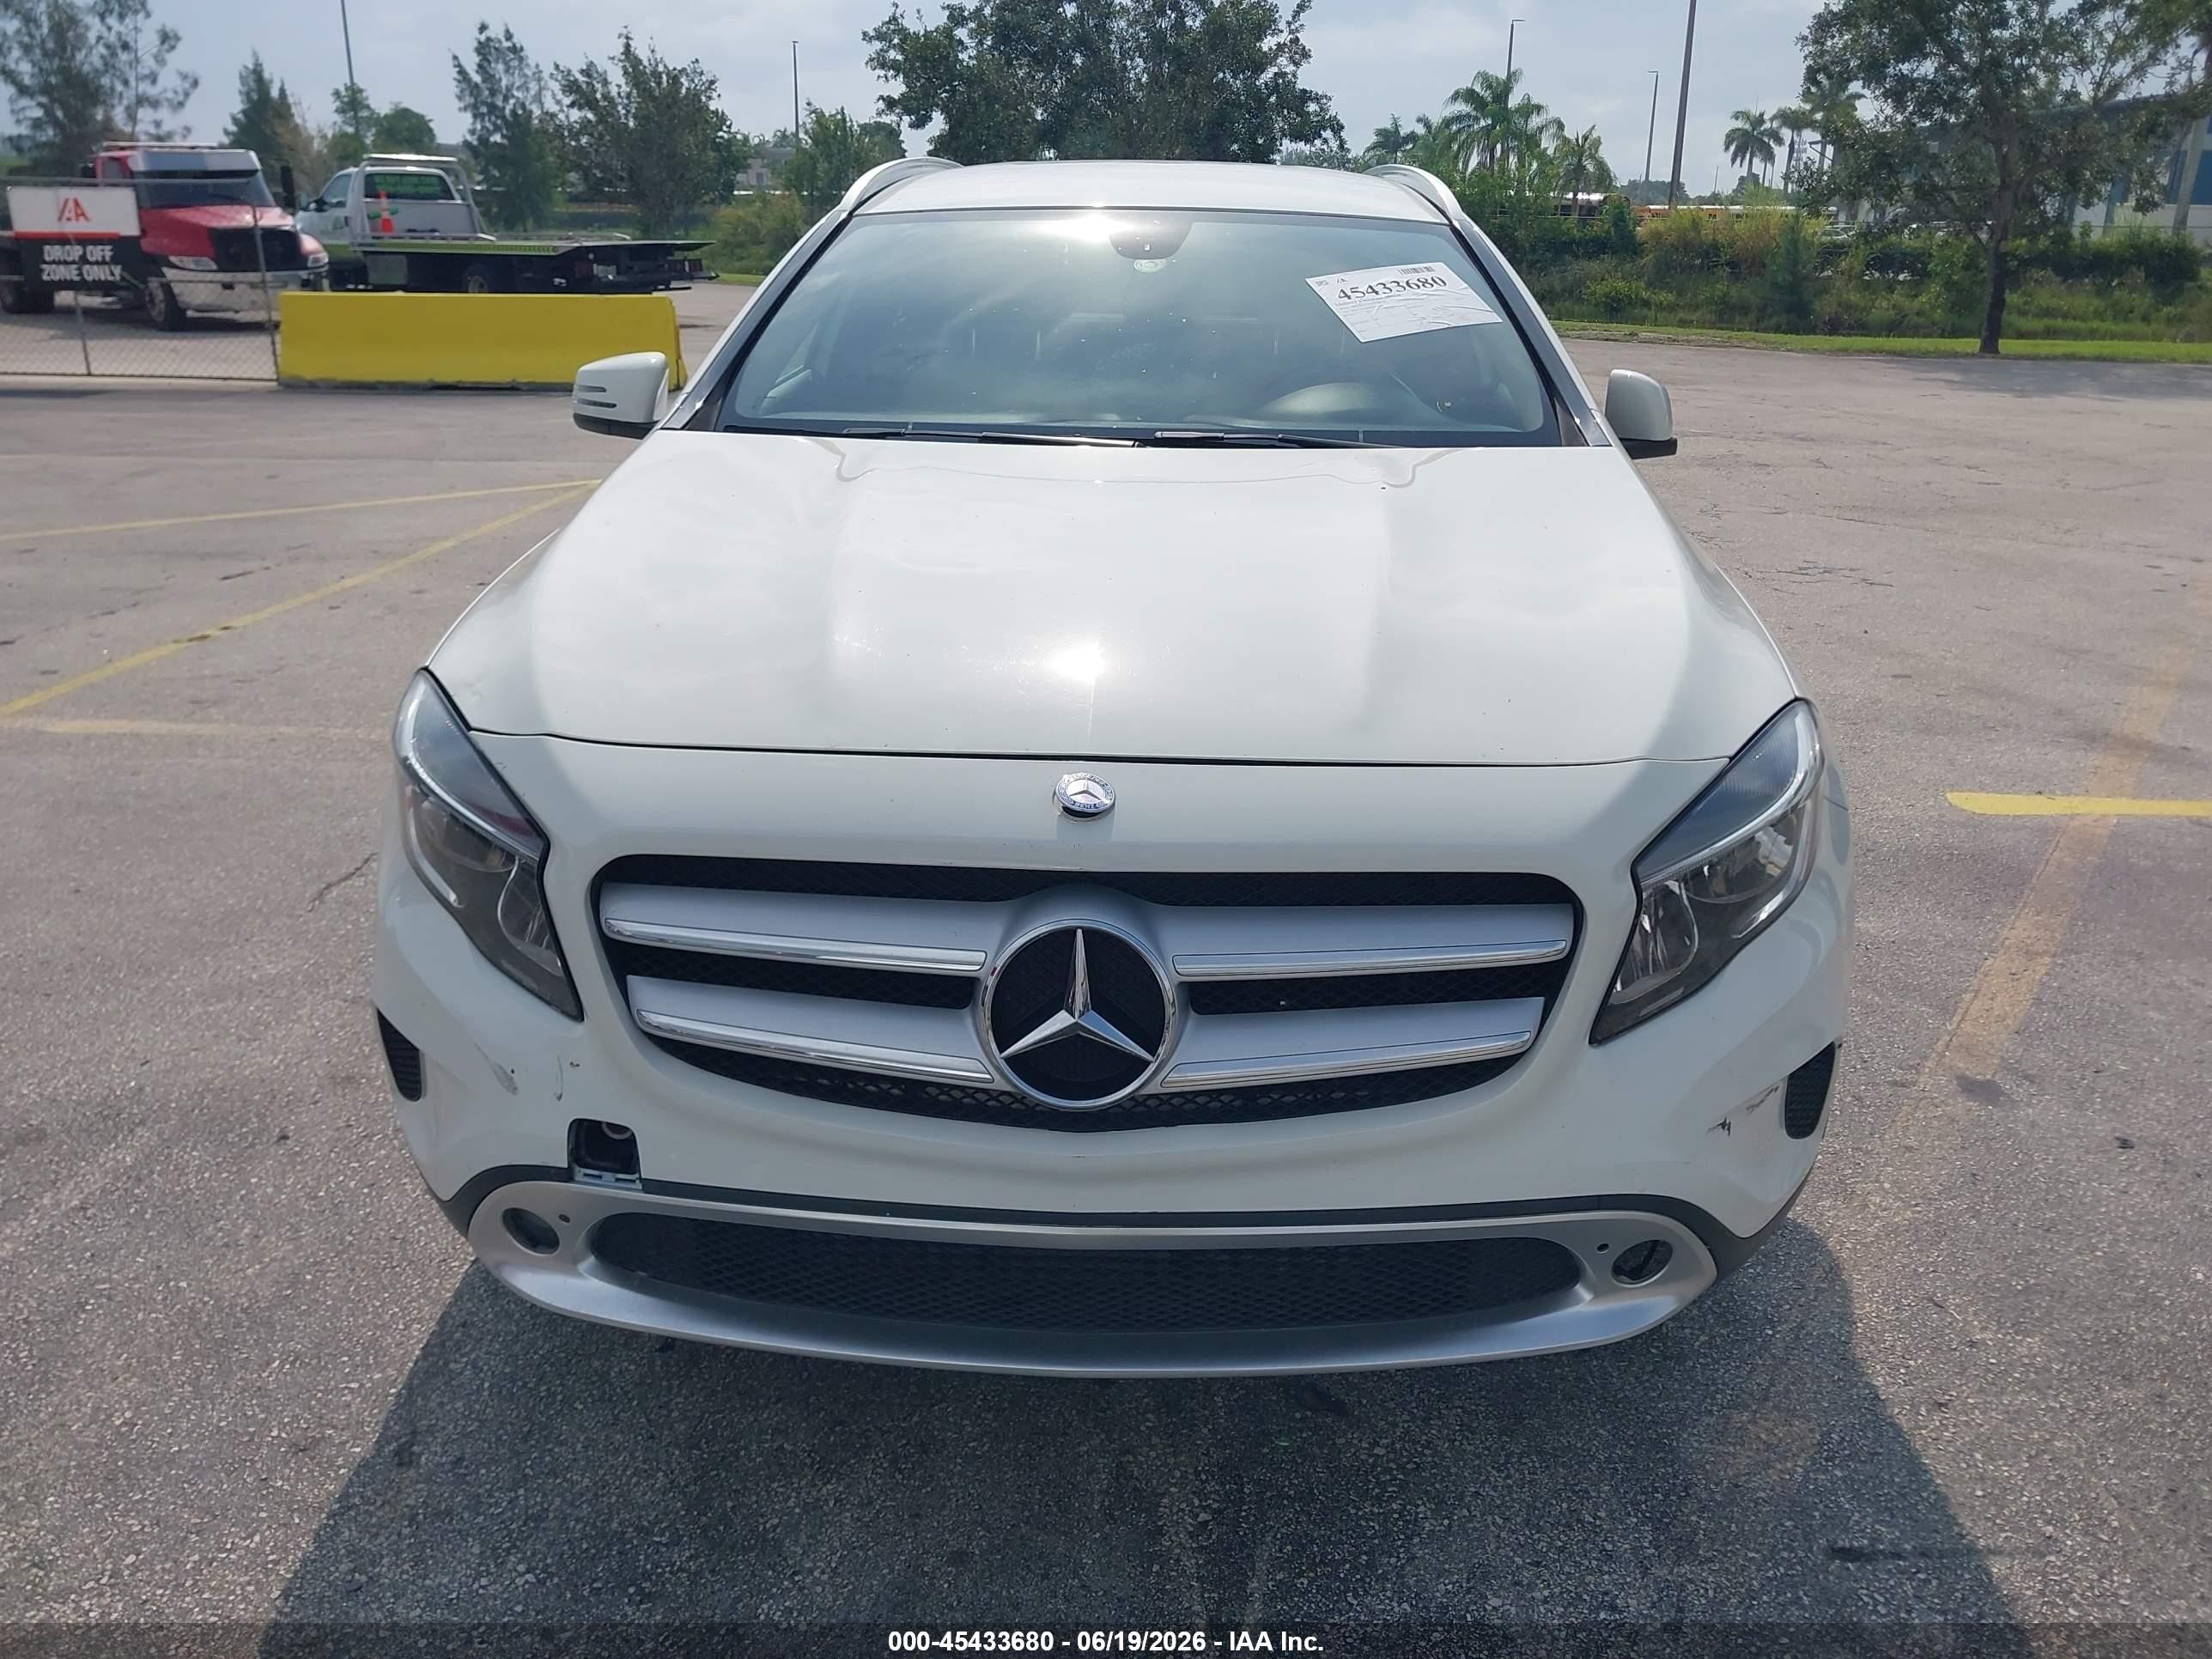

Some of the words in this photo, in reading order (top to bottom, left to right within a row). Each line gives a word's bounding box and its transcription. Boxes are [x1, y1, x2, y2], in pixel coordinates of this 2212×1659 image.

[43, 245, 83, 262] DROP
[86, 245, 113, 262] OFF
[40, 264, 81, 282] ZONE
[82, 264, 123, 282] ONLY
[1338, 276, 1447, 300] 45433680
